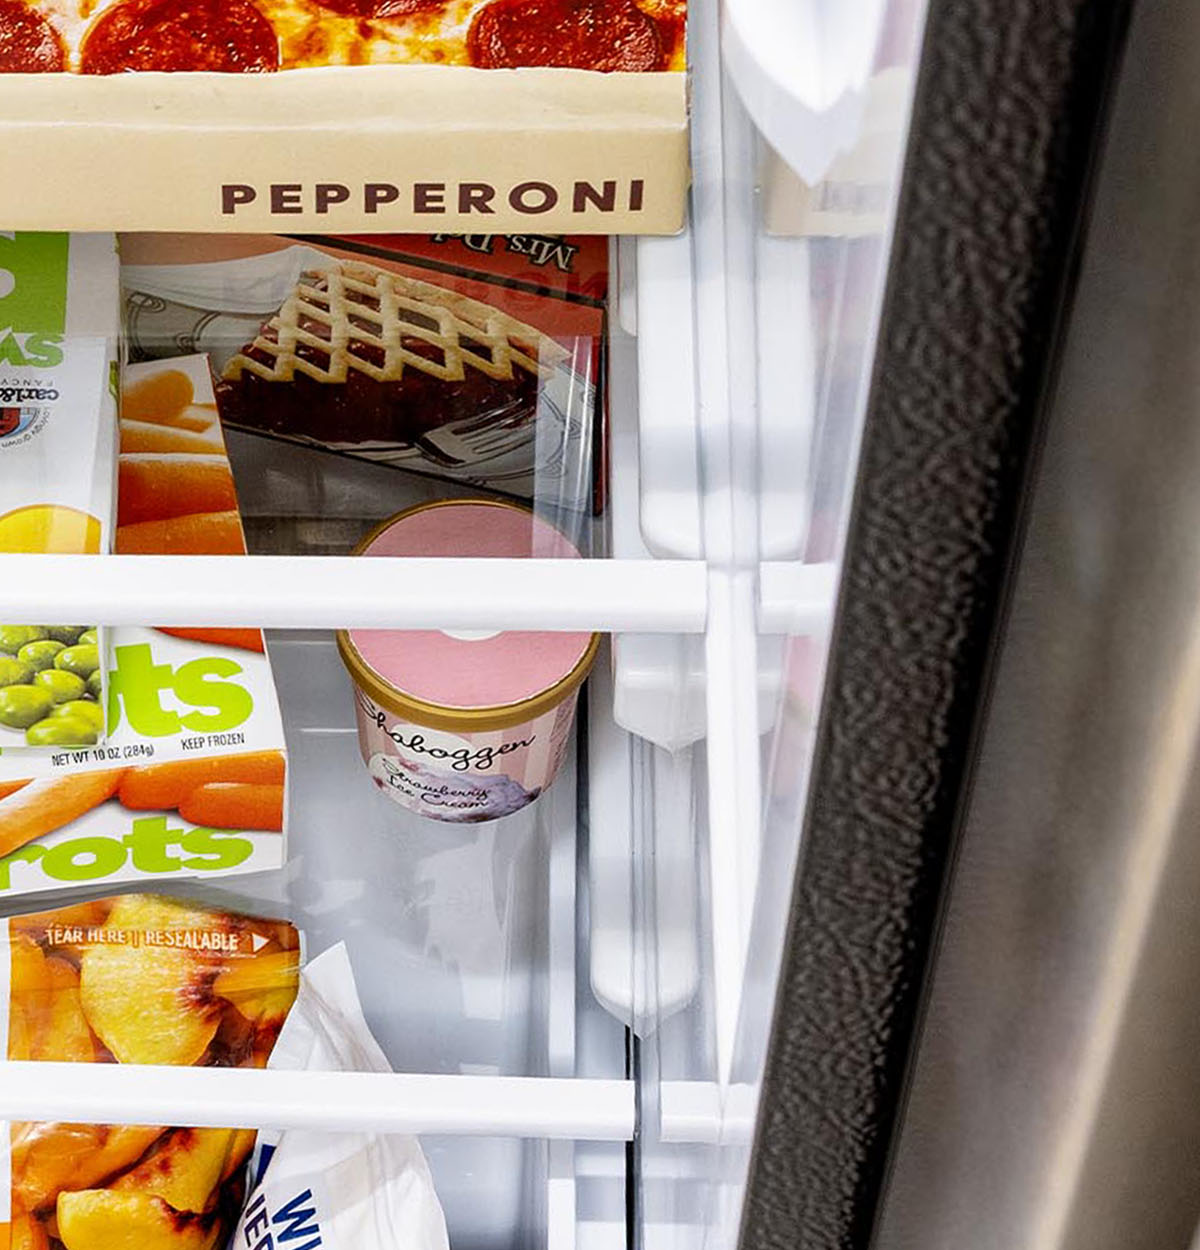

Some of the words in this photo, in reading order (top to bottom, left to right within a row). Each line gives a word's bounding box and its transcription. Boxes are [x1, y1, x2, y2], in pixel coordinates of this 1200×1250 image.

[220, 179, 645, 214] PEPPERONI
[181, 737, 206, 751] KEEP
[208, 732, 246, 747] FROZEN
[51, 754, 70, 767] NET
[73, 750, 90, 764] WT
[93, 748, 106, 761] 10
[107, 747, 121, 760] OZ
[123, 744, 155, 761] (284g)
[420, 793, 490, 808] Cream
[45, 928, 83, 945] TEAR
[87, 928, 126, 944] HERE
[146, 930, 238, 951] RESEALABLE
